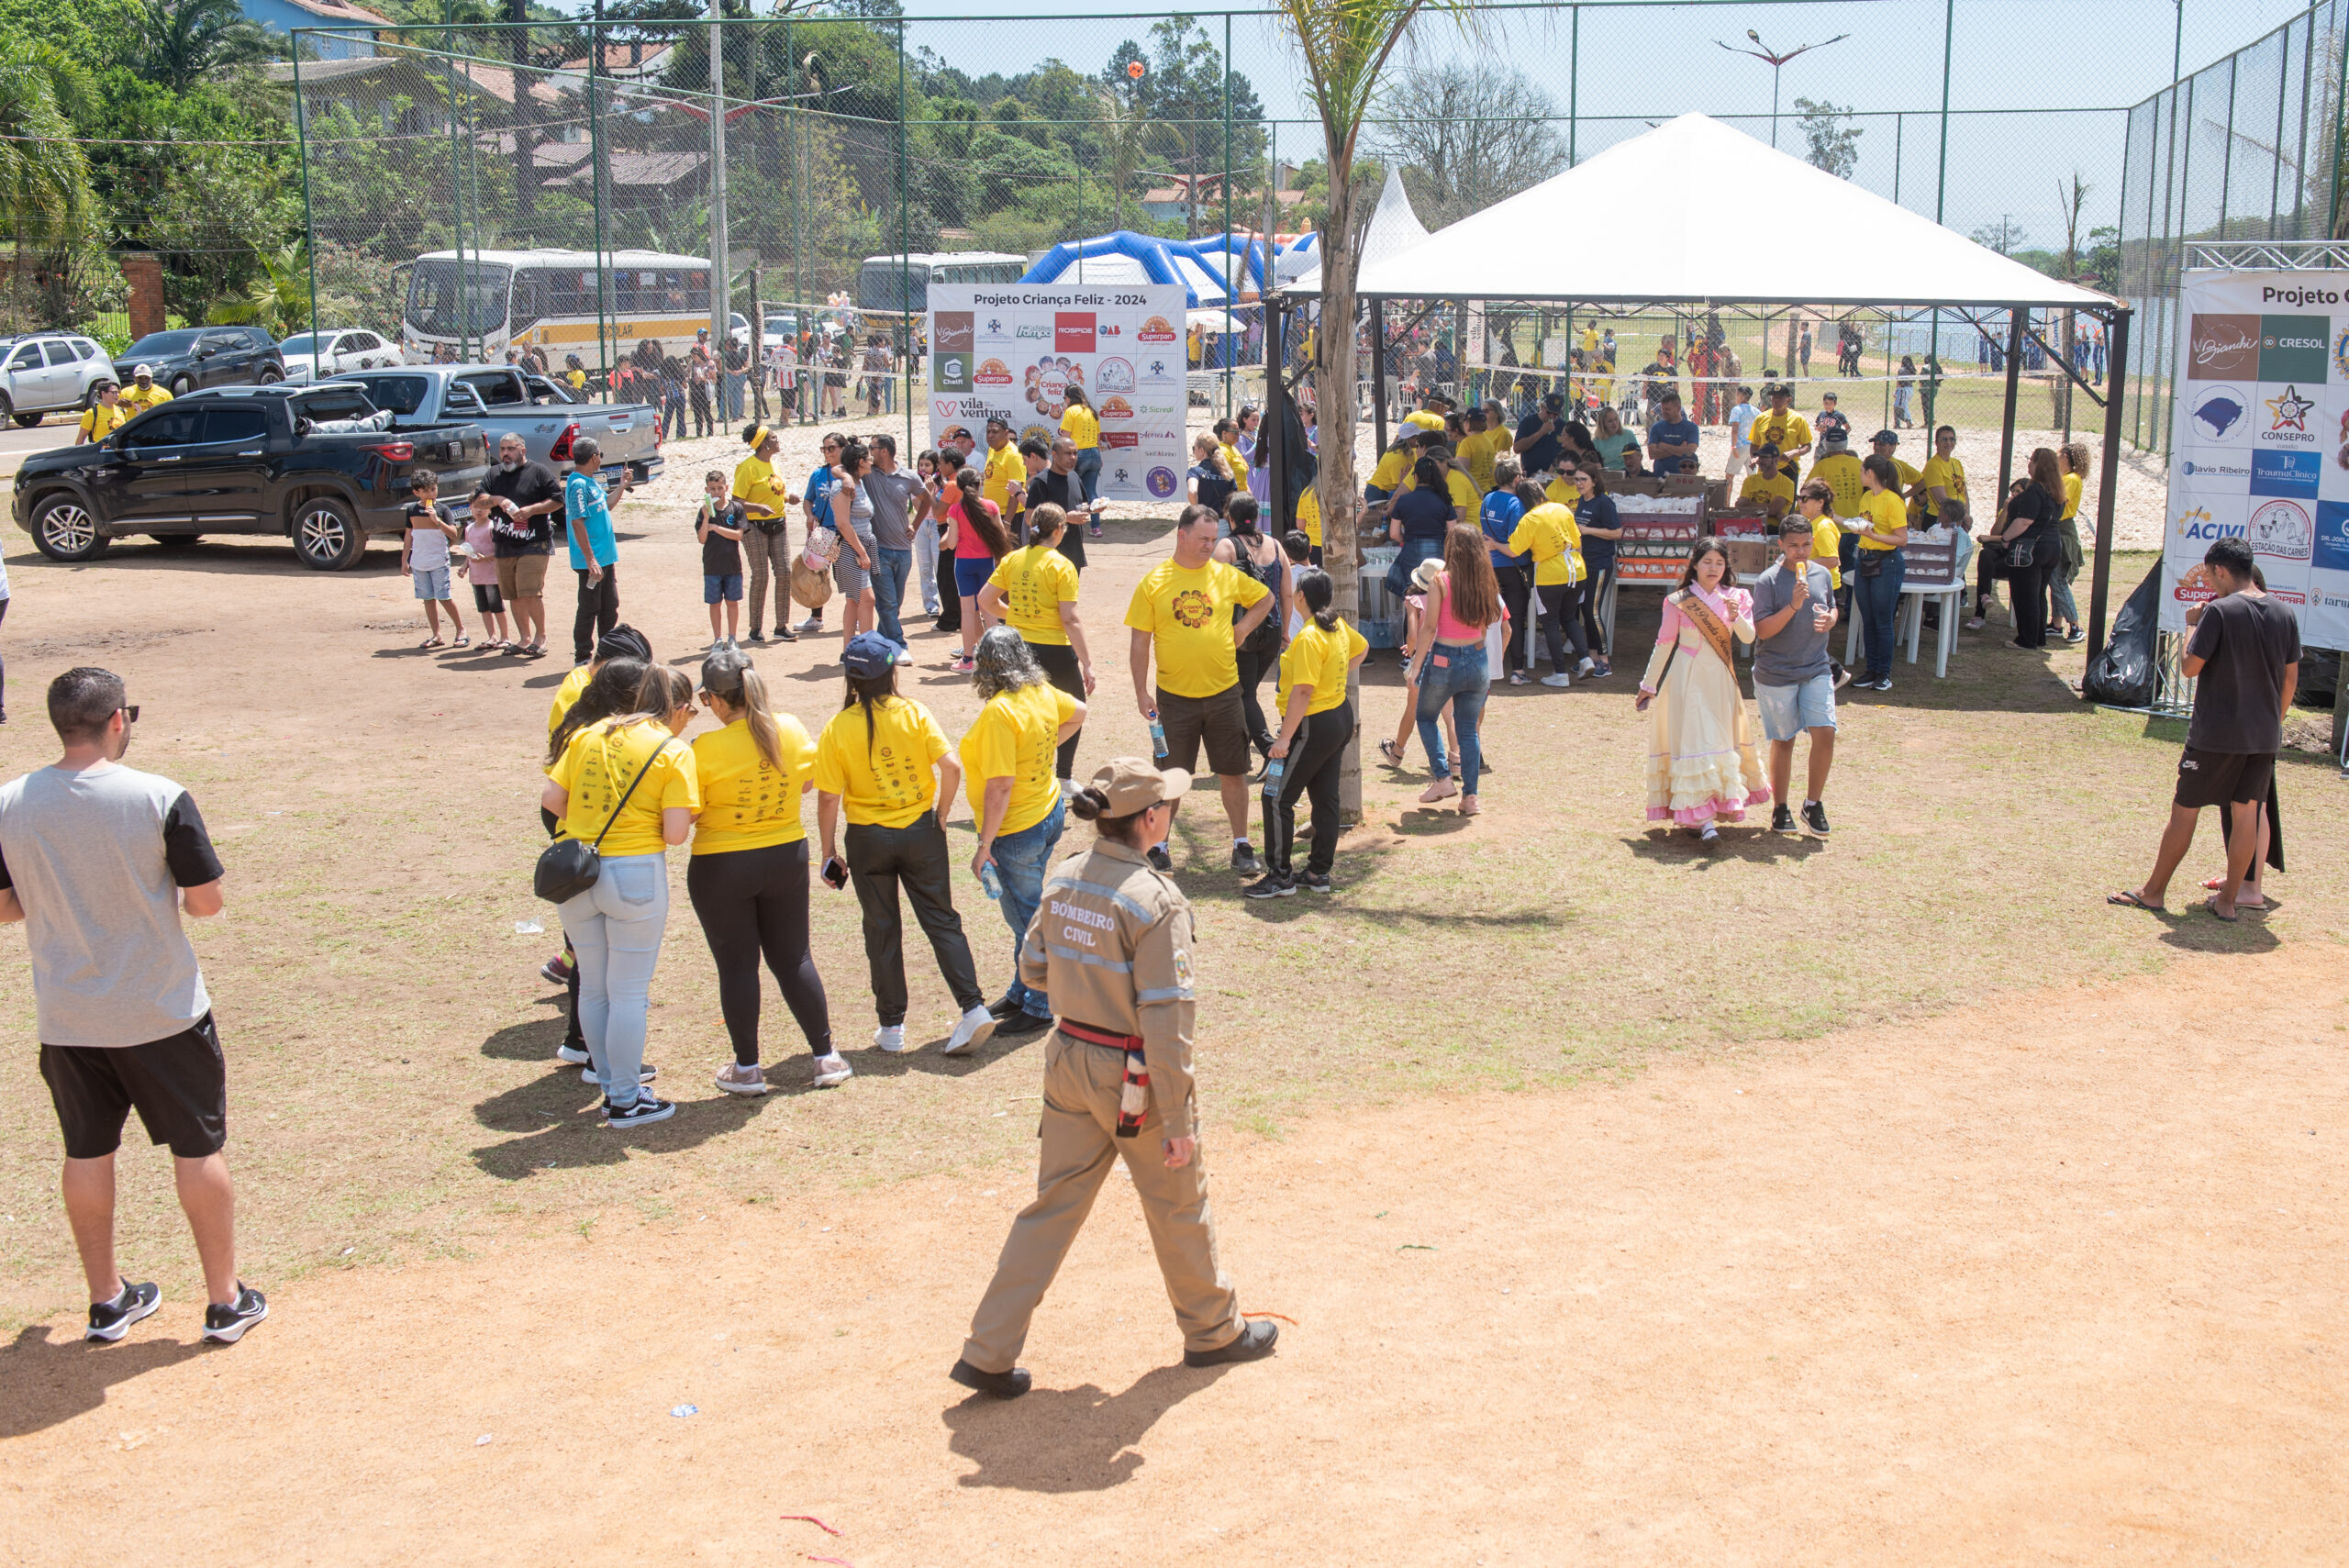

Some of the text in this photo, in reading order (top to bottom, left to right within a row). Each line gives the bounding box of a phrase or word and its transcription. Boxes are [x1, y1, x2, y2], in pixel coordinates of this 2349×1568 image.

[974, 294, 1020, 307] Projeto
[1022, 294, 1071, 307] Criança
[1074, 294, 1105, 306] Feliz
[1114, 295, 1147, 306] 2024
[2263, 285, 2339, 307] Projeto
[1098, 325, 1121, 336] OAB
[1141, 333, 1173, 341] Superpan
[2279, 338, 2325, 349] CRESOL
[977, 375, 1009, 384] Superpan
[1041, 381, 1068, 389] Criança
[960, 397, 984, 409] vila
[960, 408, 1012, 418] ventura
[1102, 410, 1130, 418] Superpan
[1149, 406, 1174, 414] Sicredi
[2261, 431, 2315, 442] CONSEPRO
[2220, 466, 2251, 474] Ribeiro
[2256, 467, 2317, 480] TraumaClínica
[2186, 522, 2245, 539] ACIVI
[2251, 541, 2309, 557] ESTAÇÃO DAS CARNES
[2179, 588, 2217, 601] Super
[1051, 900, 1115, 932] BOMBEIRO
[1063, 925, 1097, 948] CIVIL
